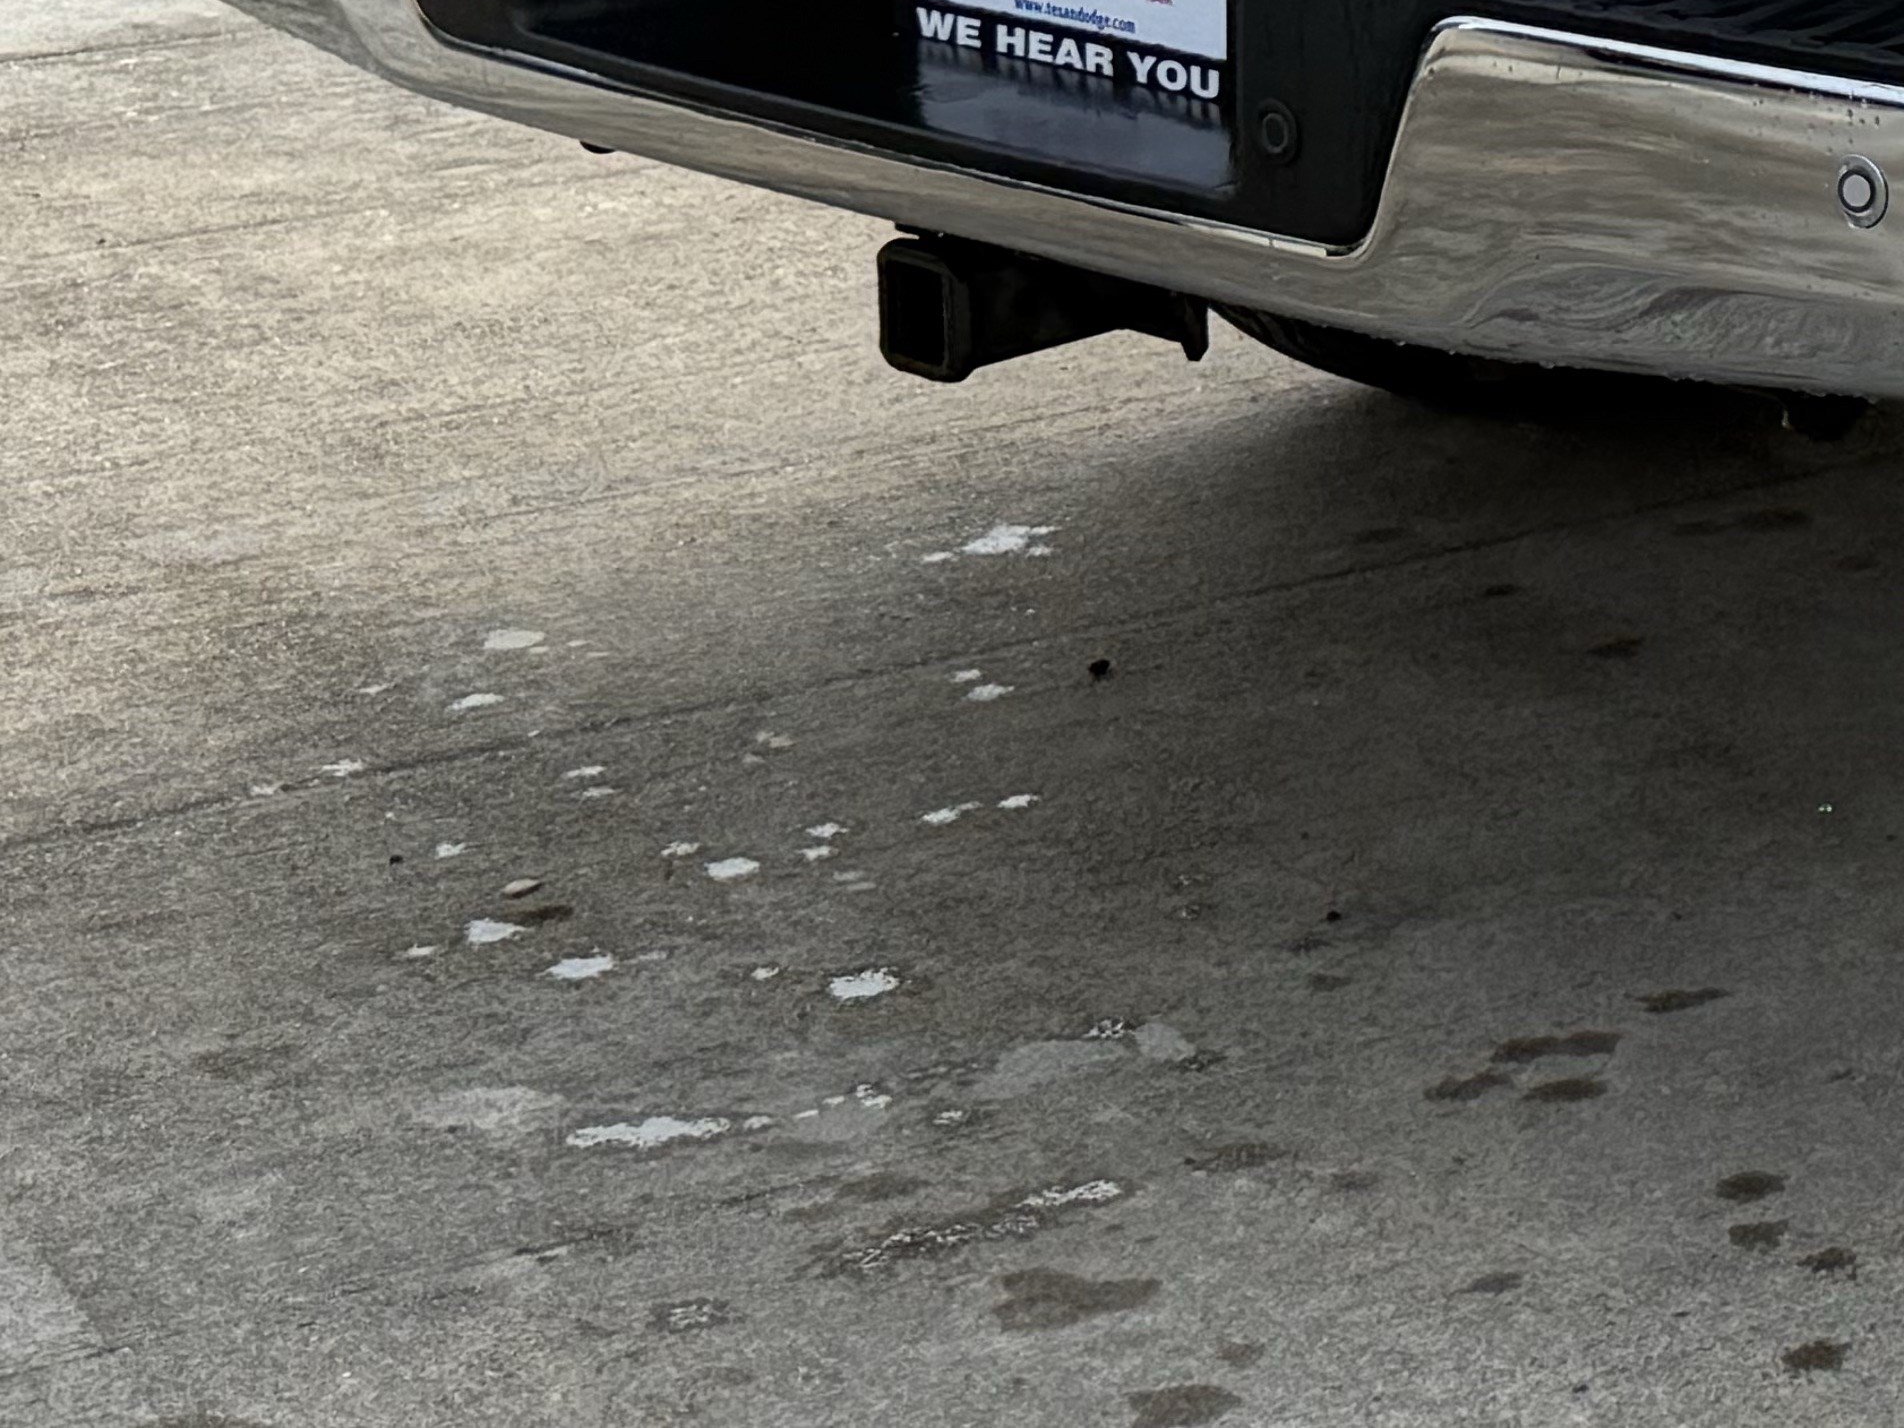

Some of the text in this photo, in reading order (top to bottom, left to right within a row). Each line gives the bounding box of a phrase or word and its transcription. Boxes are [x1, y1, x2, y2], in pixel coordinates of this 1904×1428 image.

[915, 6, 1220, 100] WE HEAR YOU
